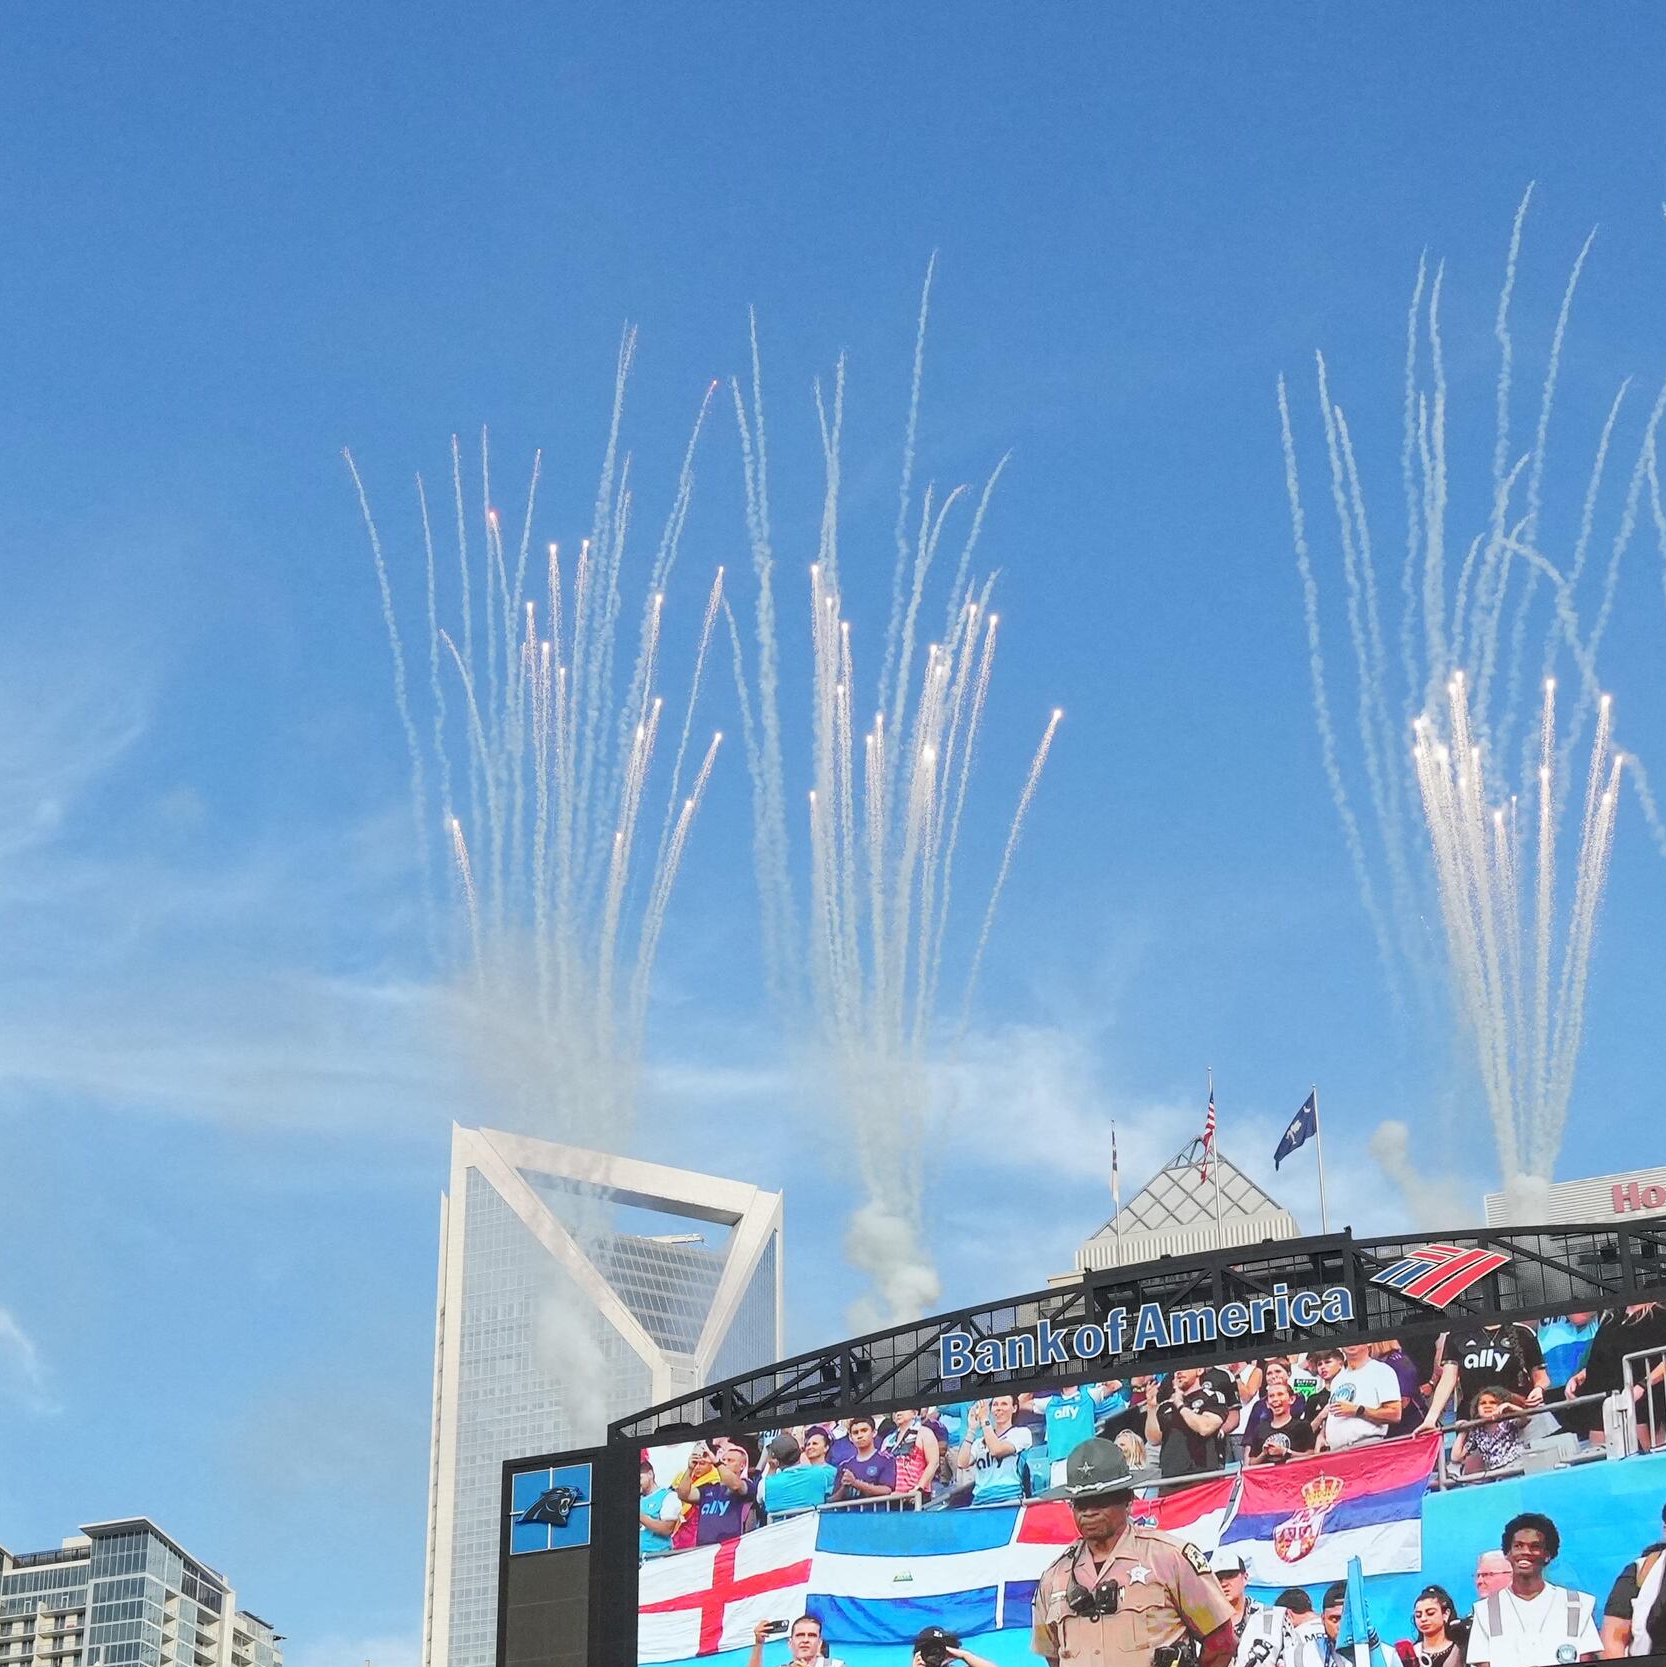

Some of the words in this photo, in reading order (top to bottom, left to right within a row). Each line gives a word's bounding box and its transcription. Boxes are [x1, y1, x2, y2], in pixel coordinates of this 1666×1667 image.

[940, 1320, 1070, 1379] Bank
[1072, 1306, 1132, 1359] of
[1132, 1282, 1355, 1350] America
[1464, 1349, 1510, 1372] ally
[1054, 1405, 1079, 1420] ally
[701, 1500, 730, 1516] ally
